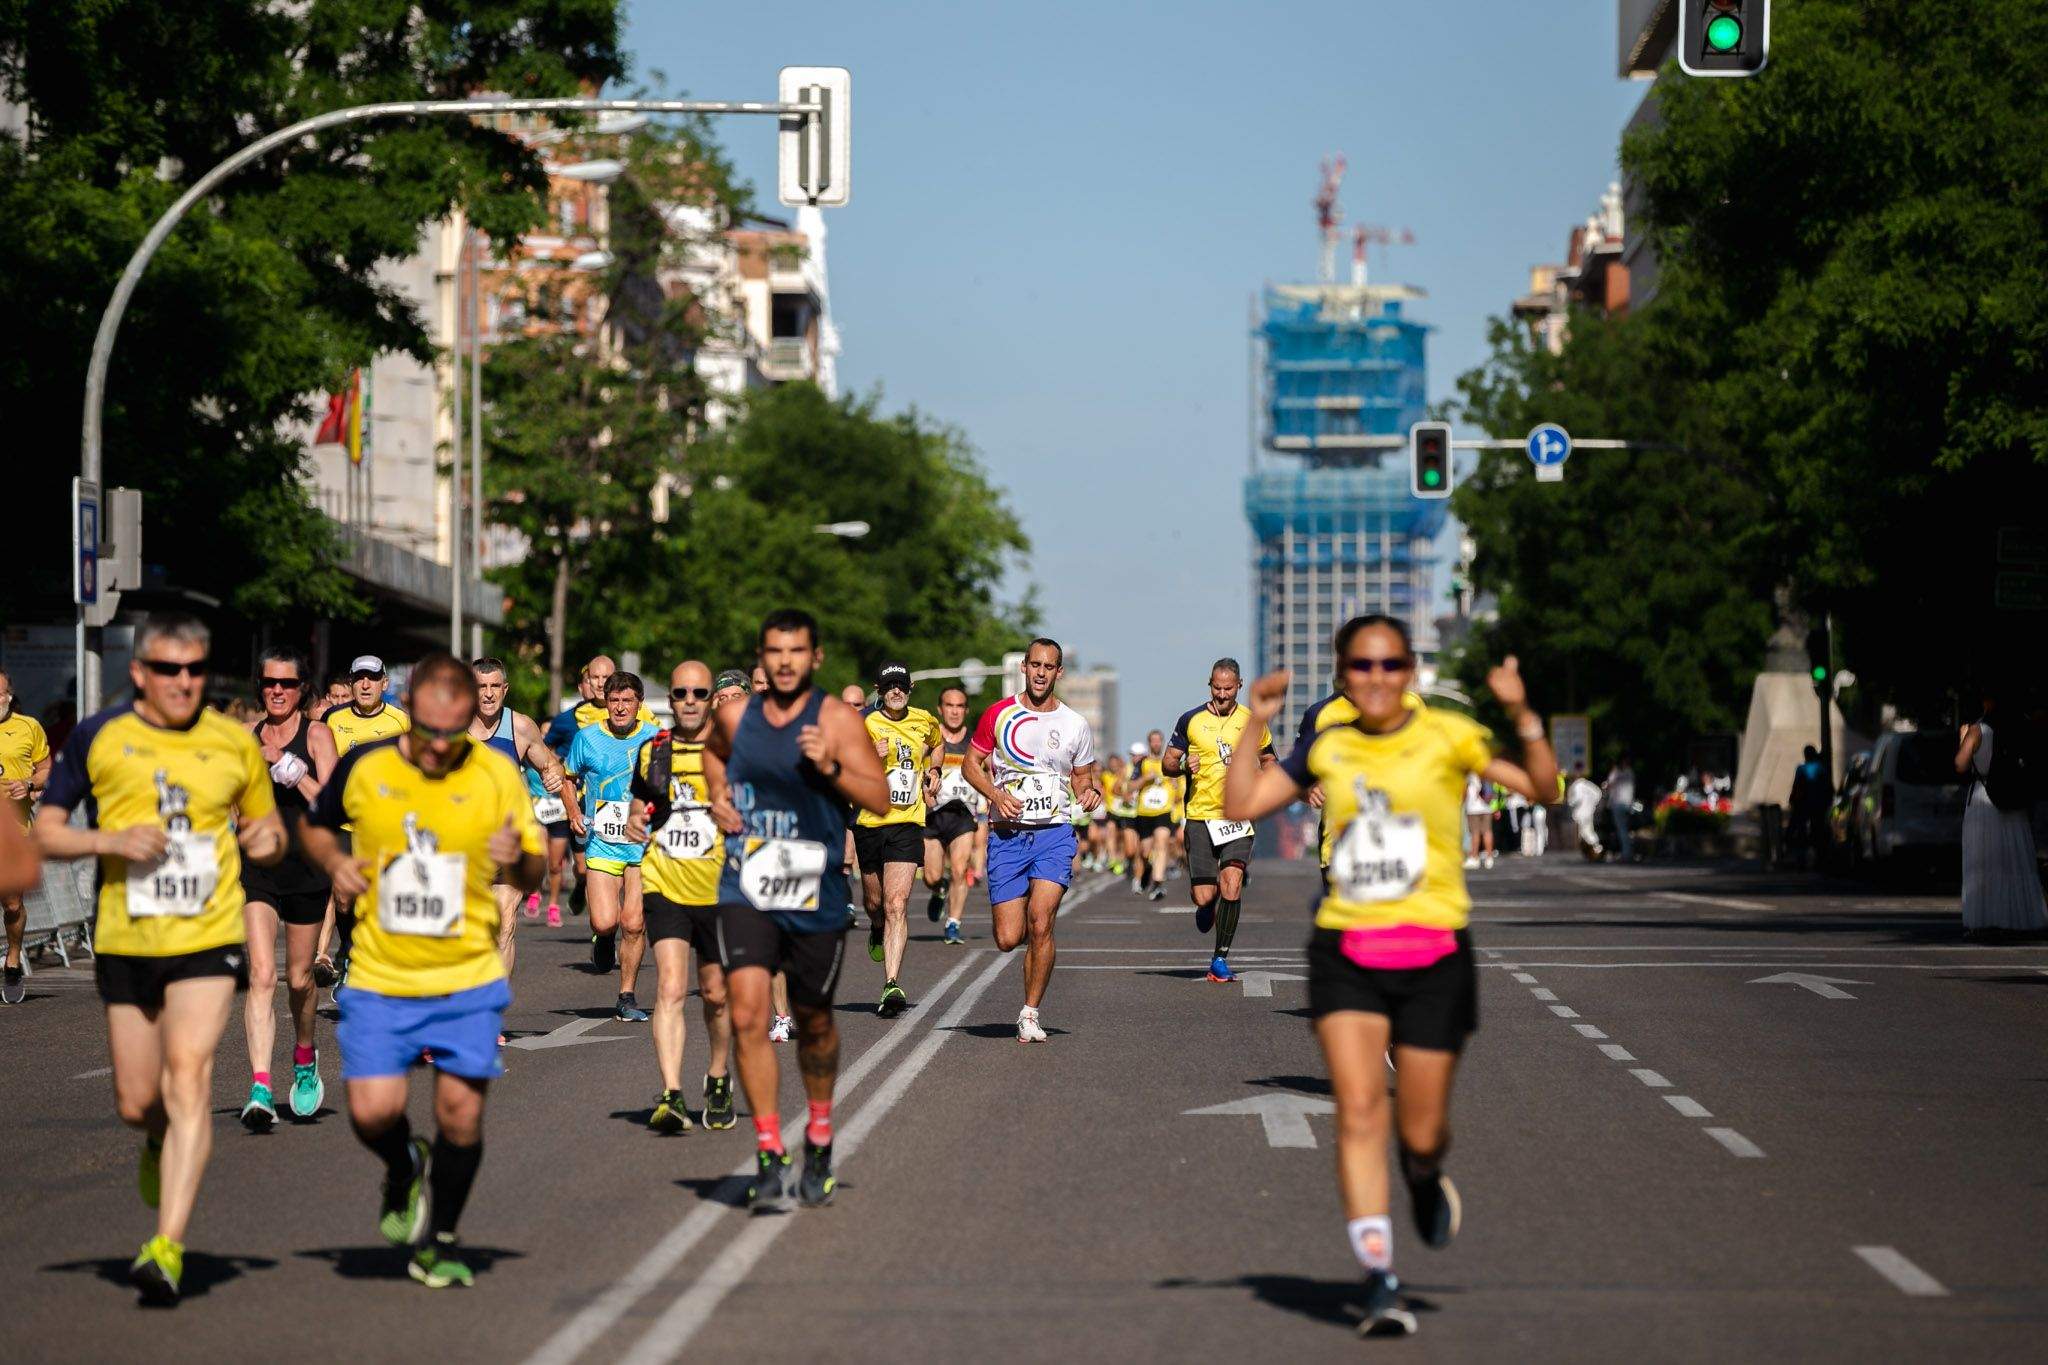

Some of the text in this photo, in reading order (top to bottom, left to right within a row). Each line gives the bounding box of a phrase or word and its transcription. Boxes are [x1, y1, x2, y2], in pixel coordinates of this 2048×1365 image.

[882, 666, 906, 675] adidas
[891, 791, 911, 803] 947
[1026, 796, 1052, 811] 2513
[1218, 822, 1243, 837] 1329
[668, 830, 699, 847] 1713
[155, 876, 197, 898] 1511
[395, 893, 444, 918] 1510
